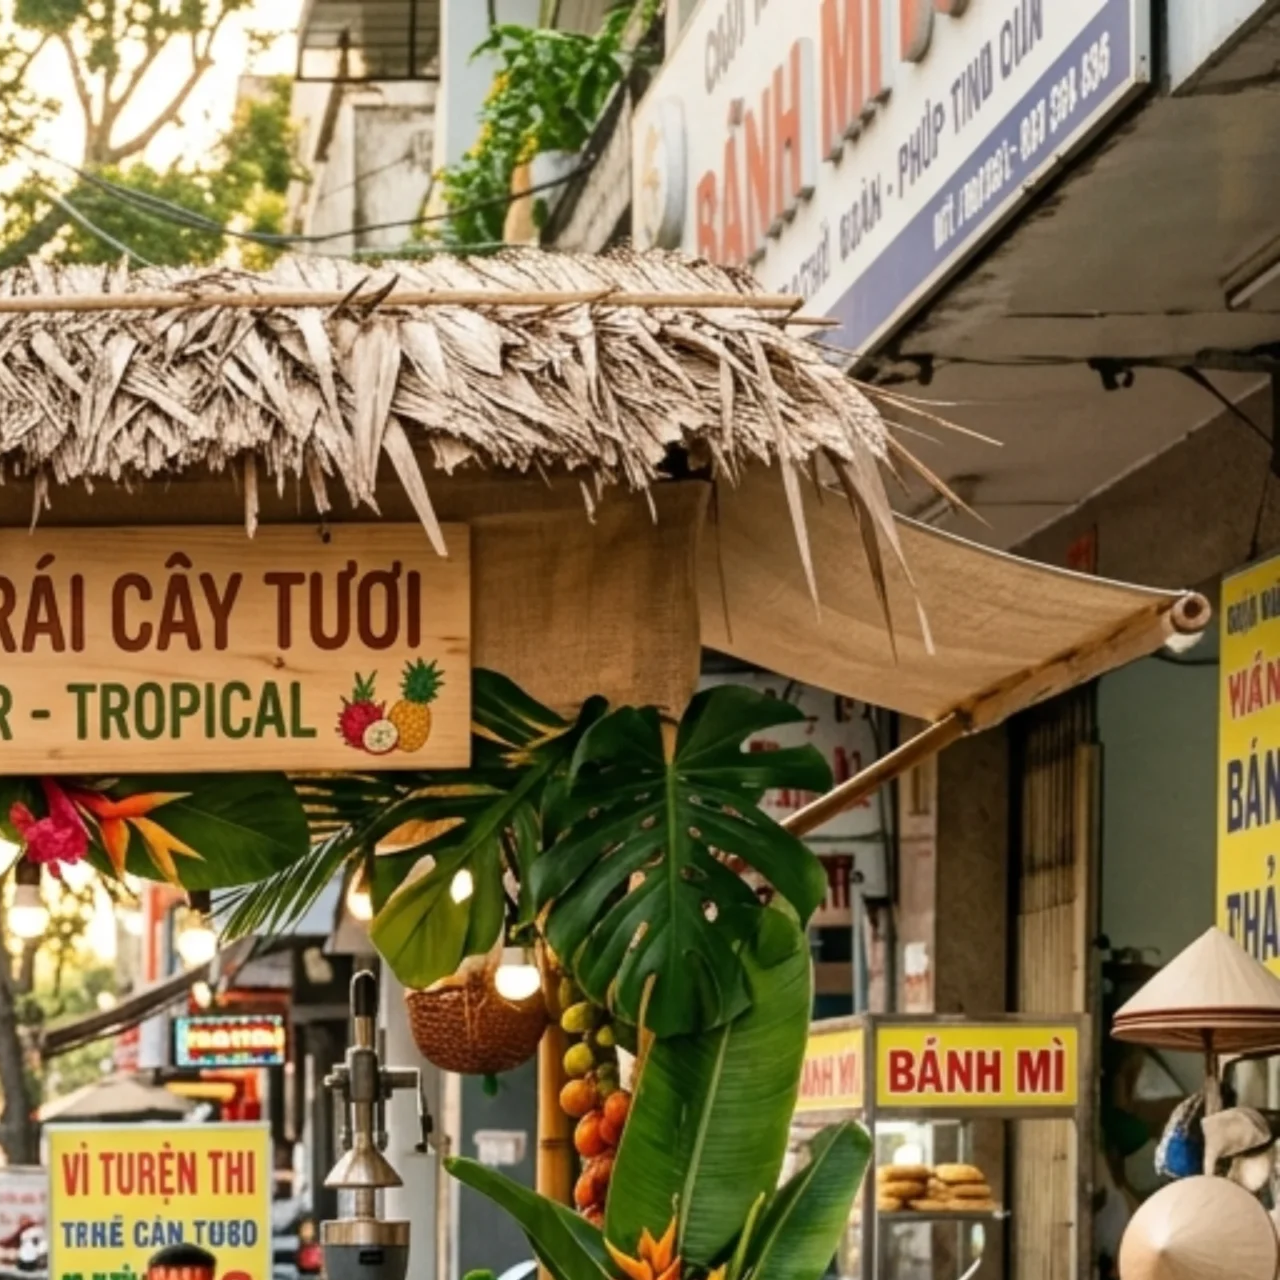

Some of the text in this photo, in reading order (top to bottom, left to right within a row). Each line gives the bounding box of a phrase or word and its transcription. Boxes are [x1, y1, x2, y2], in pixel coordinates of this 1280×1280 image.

[112, 553, 243, 652] CÂY
[264, 559, 421, 650] TƯƠI
[67, 680, 317, 740] TROPICAL
[888, 1036, 1064, 1093] BÁNH MÌ
[207, 1150, 255, 1195] THI
